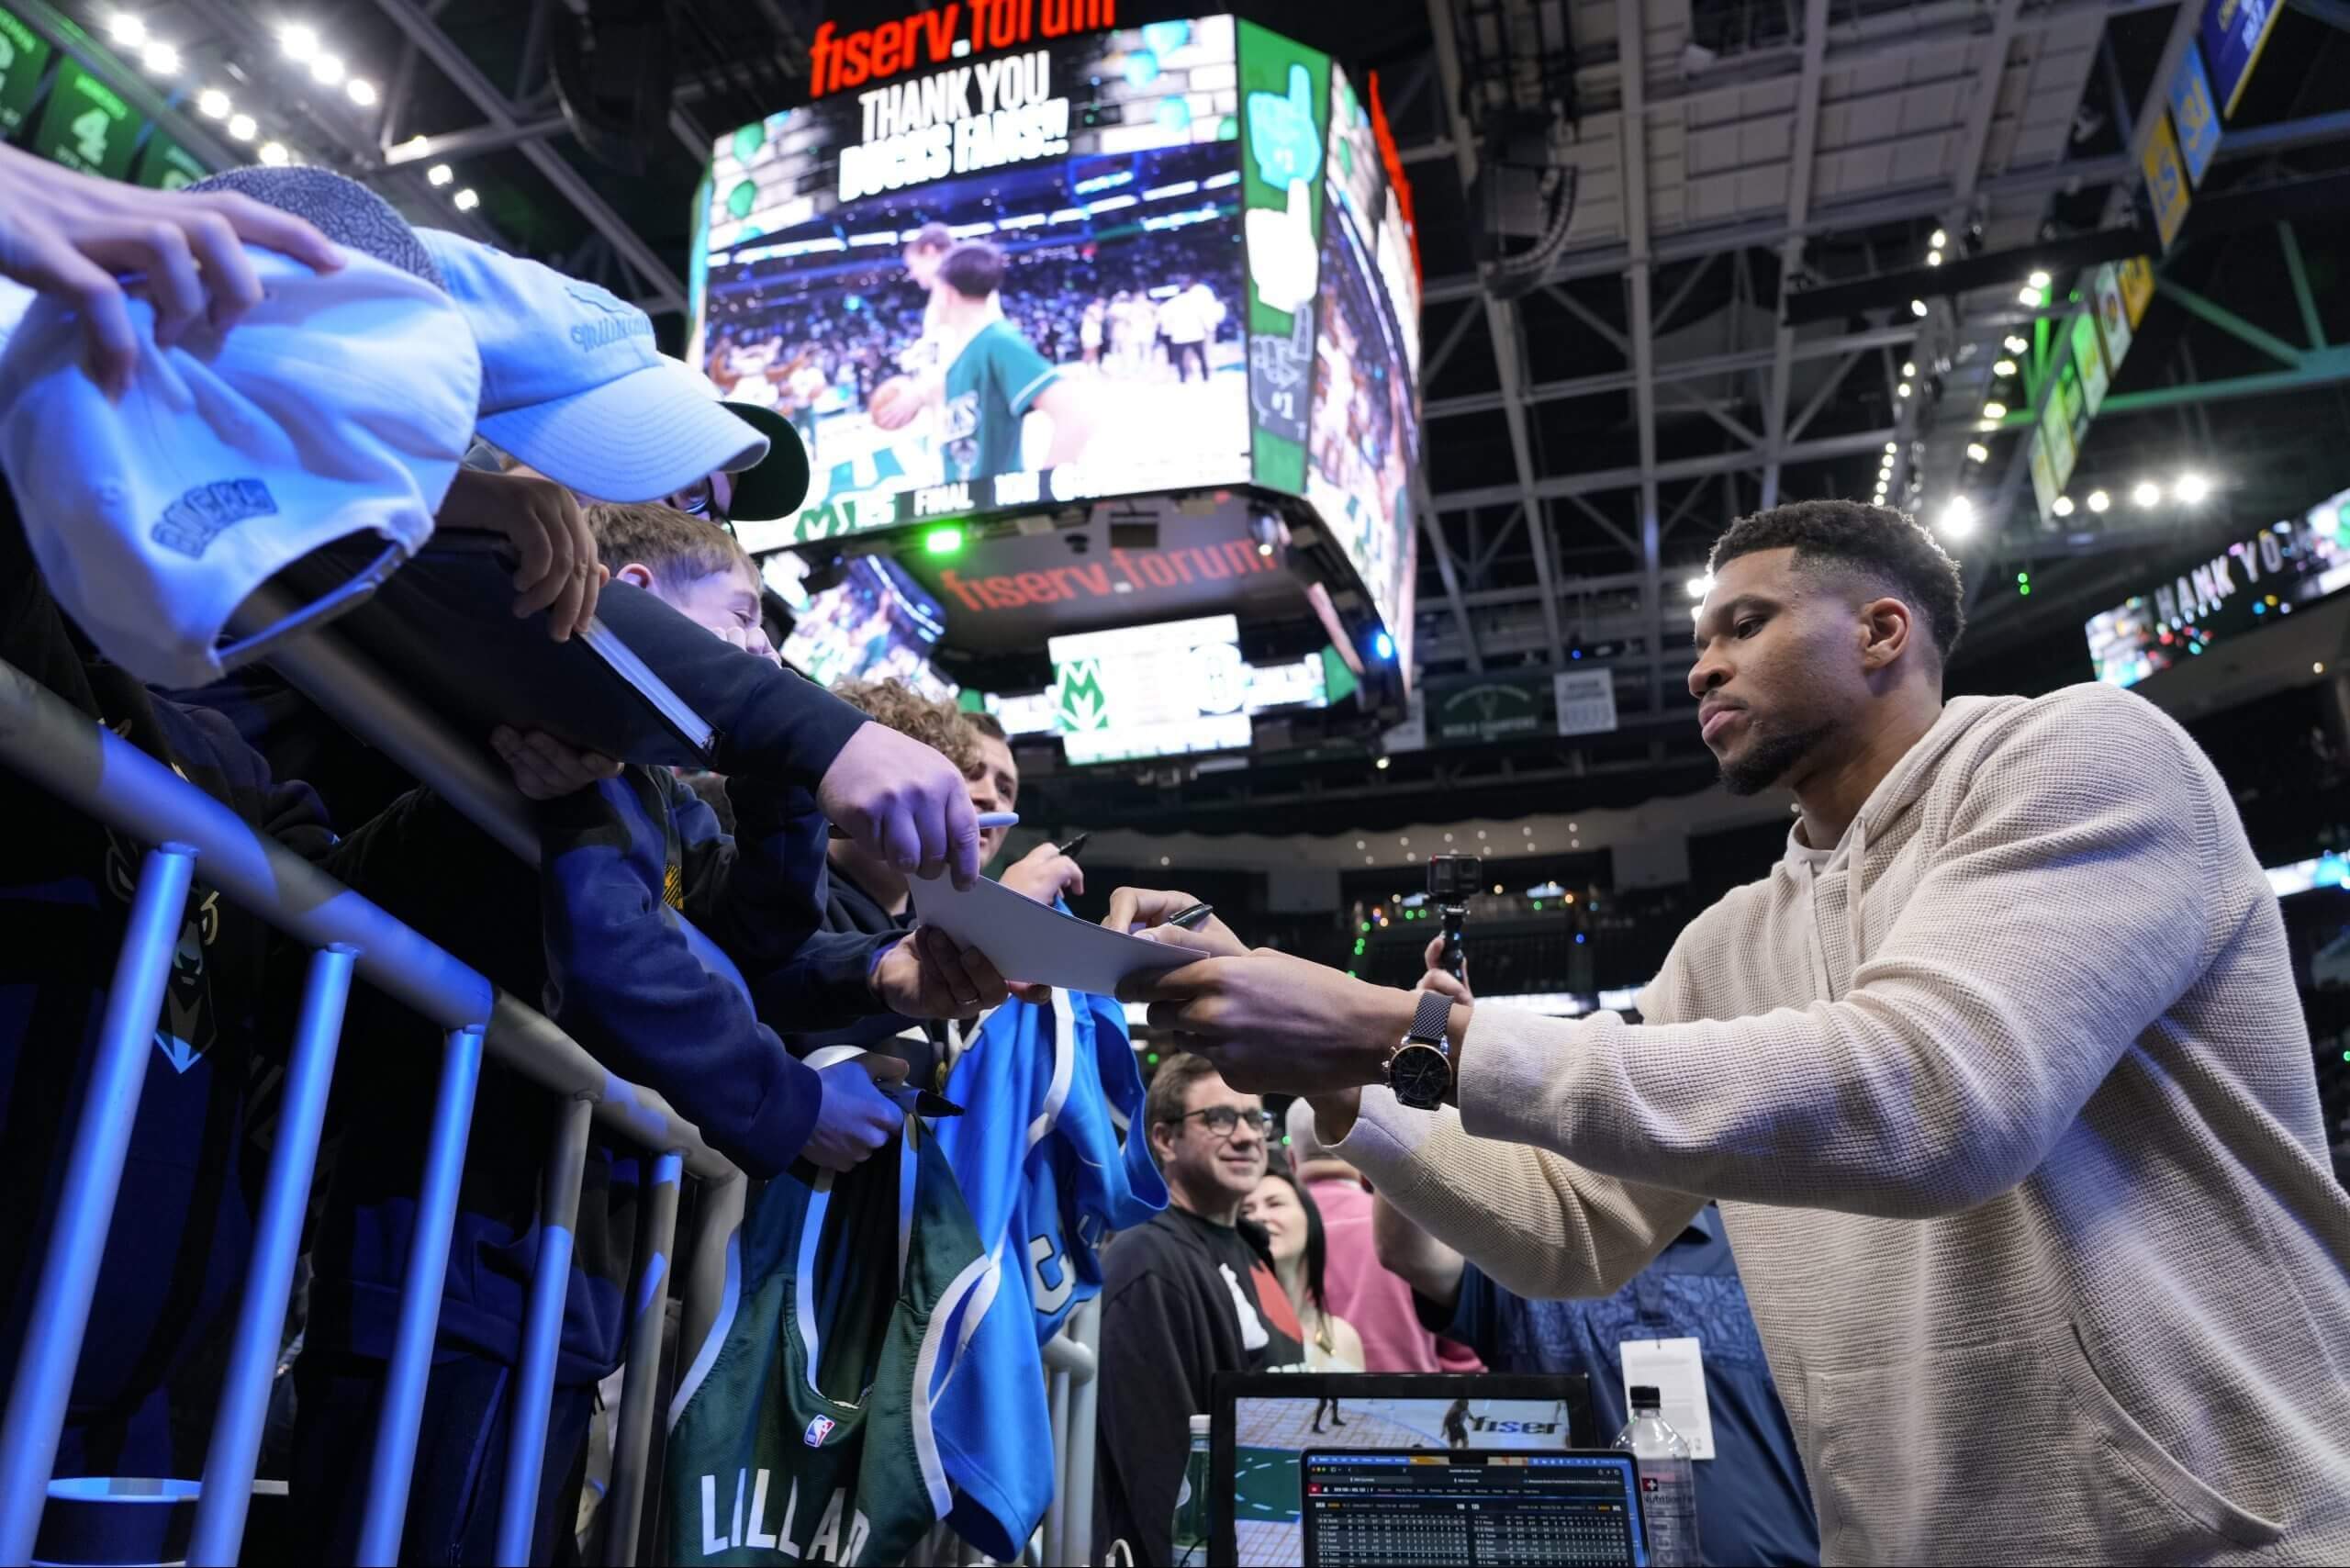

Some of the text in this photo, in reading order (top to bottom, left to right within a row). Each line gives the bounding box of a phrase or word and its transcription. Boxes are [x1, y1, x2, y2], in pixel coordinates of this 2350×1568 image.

[858, 50, 1050, 142] THANK YOU
[72, 107, 111, 165] 4
[913, 483, 975, 517] FINAL
[940, 537, 1278, 612] fiserv.forum
